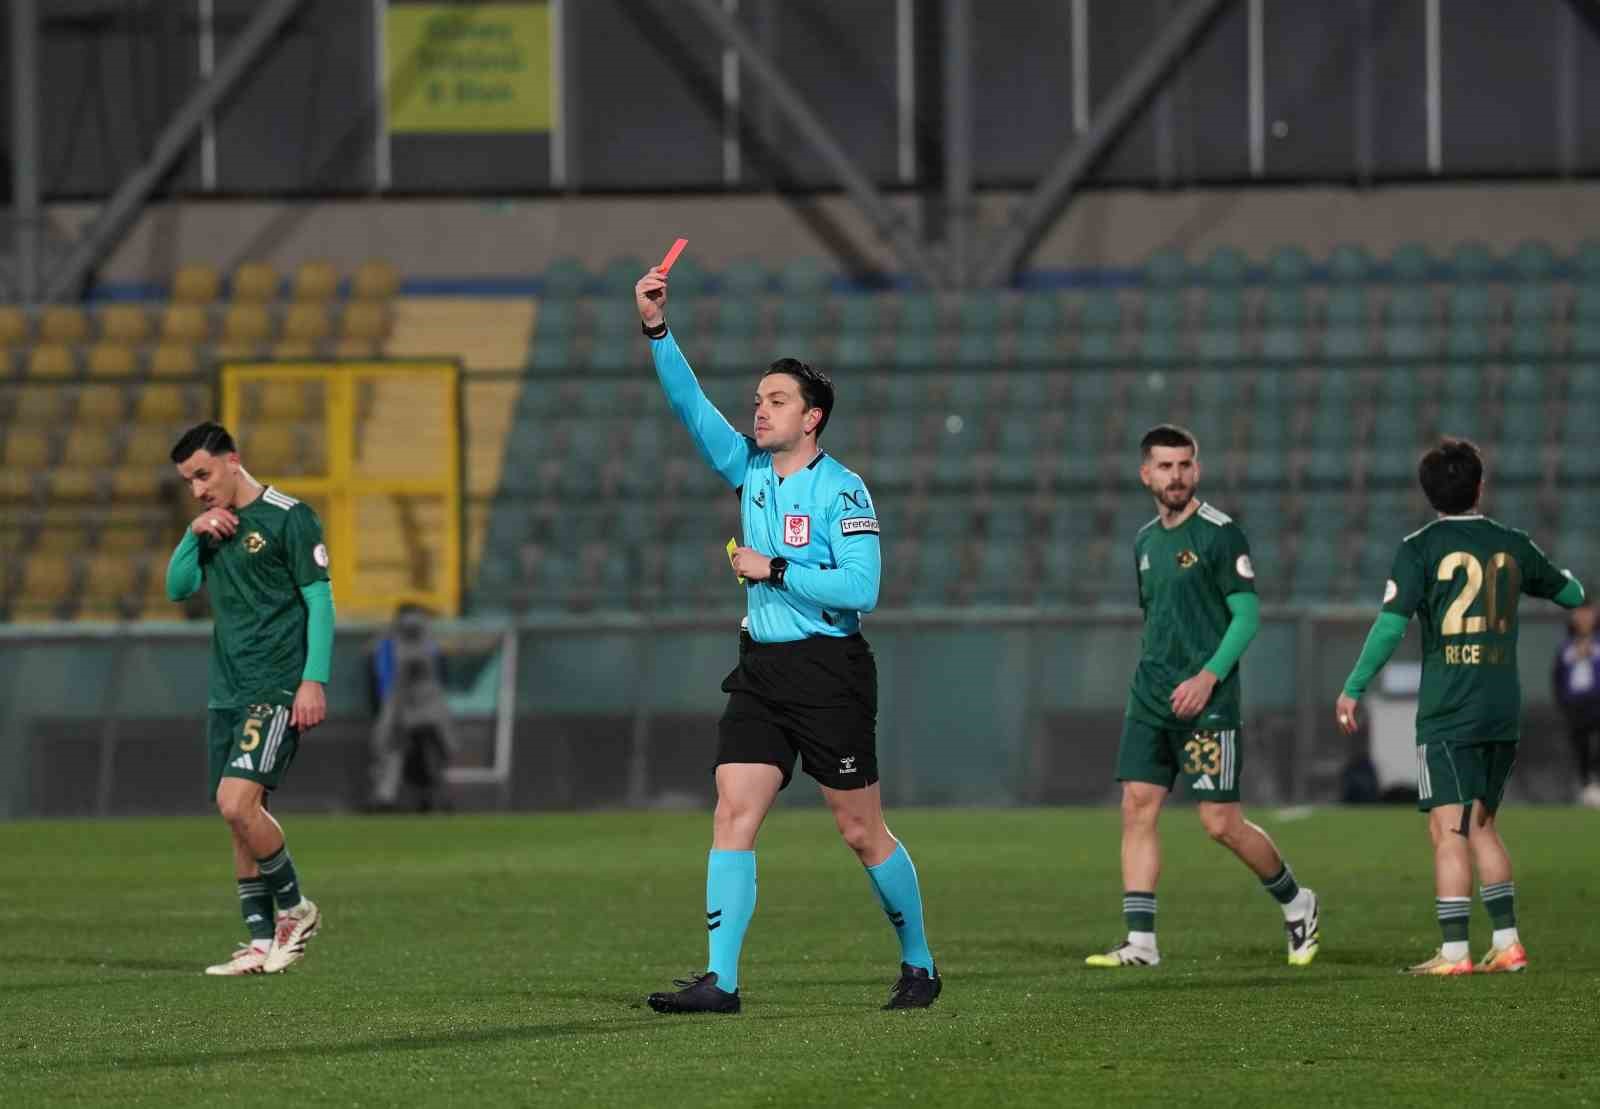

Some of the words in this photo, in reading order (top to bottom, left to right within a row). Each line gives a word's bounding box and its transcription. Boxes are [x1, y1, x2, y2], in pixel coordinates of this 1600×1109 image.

[1437, 551, 1521, 636] 20
[240, 718, 263, 752] 5
[1183, 739, 1222, 775] 33
